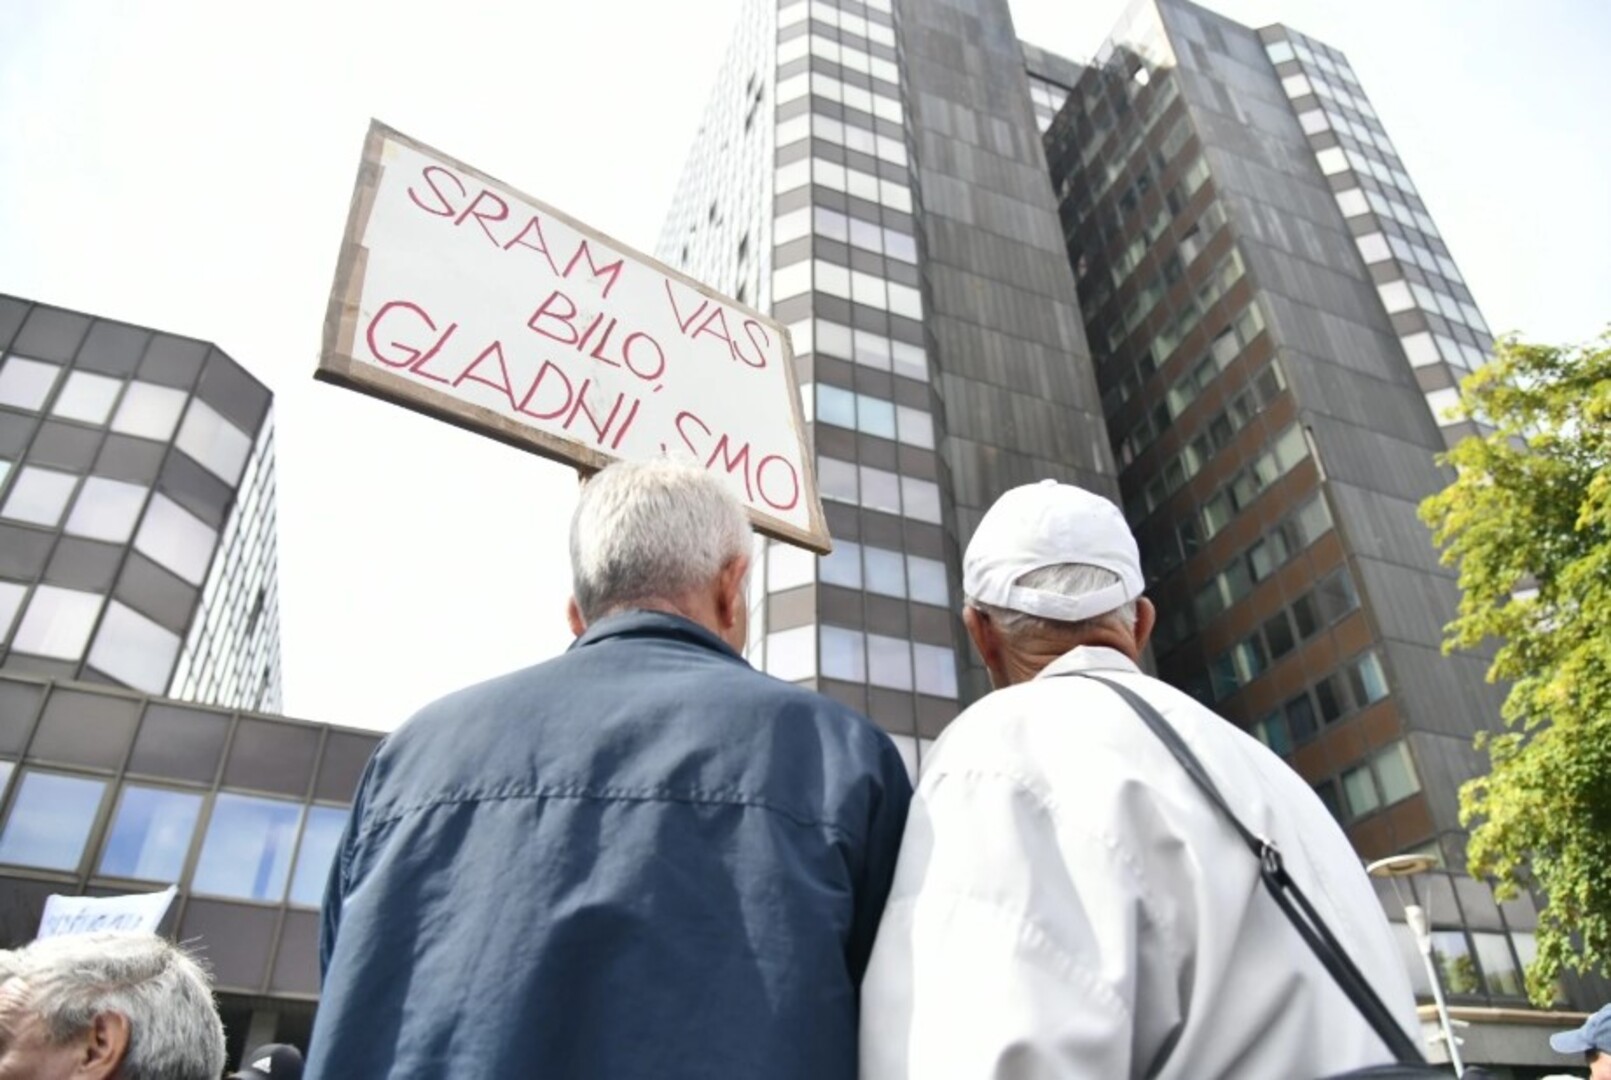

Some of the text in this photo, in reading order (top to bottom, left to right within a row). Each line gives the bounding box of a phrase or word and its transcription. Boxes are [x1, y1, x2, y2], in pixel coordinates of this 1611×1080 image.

[406, 165, 769, 369] SRAM VAS
[527, 290, 666, 393] BILO,
[366, 300, 641, 449] GLADNI
